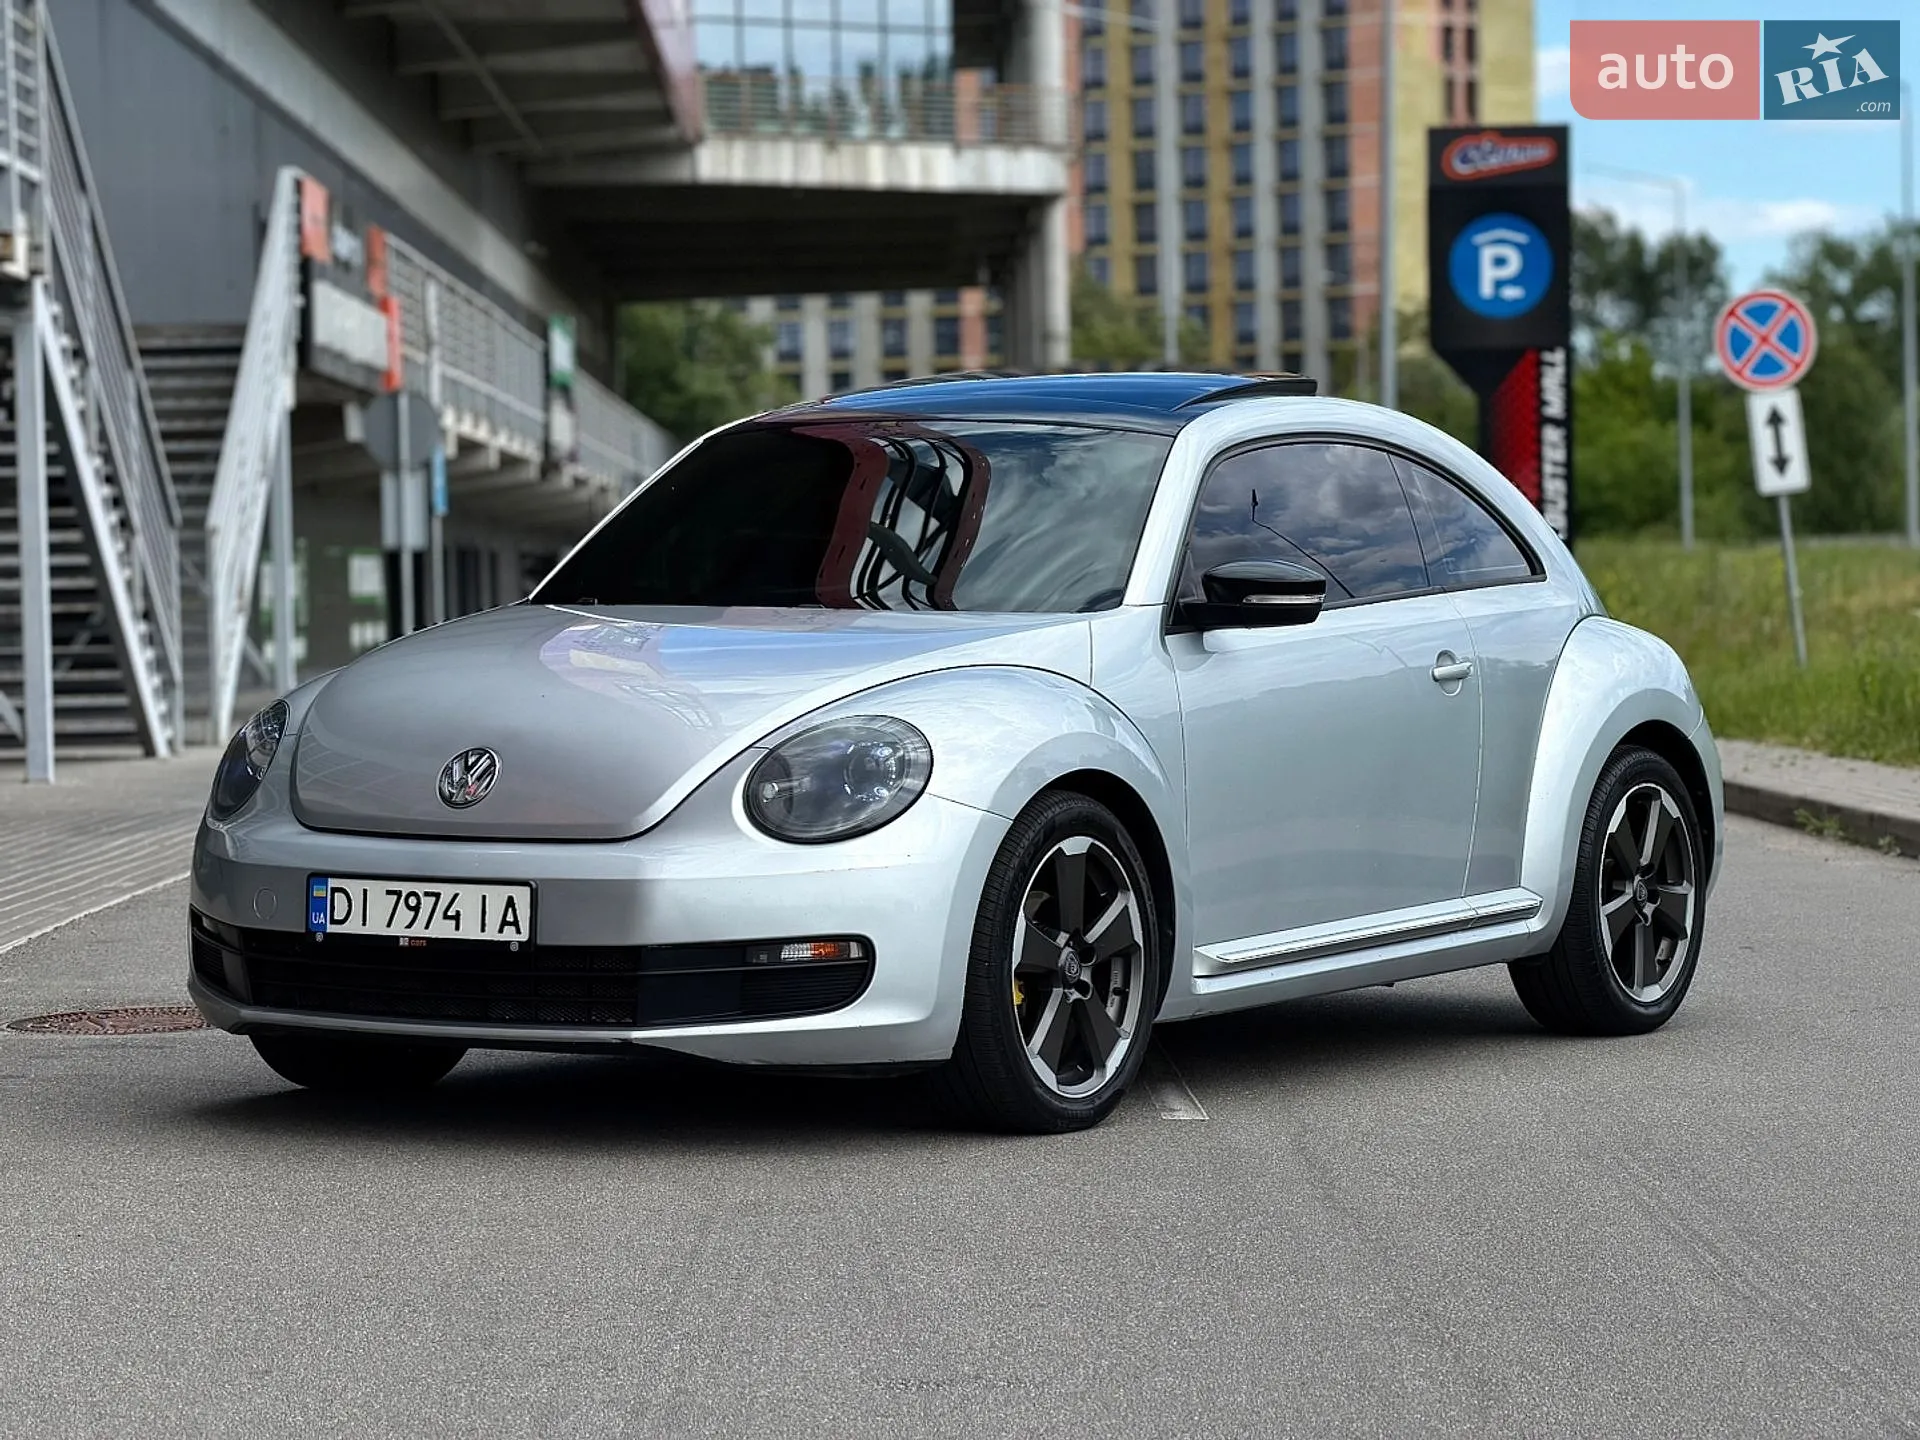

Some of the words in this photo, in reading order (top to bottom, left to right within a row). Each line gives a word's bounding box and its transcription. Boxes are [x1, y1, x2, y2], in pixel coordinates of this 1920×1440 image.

[312, 912, 326, 925] UA
[329, 886, 369, 927] DI
[385, 889, 462, 932] 7974
[481, 894, 522, 935] IA
